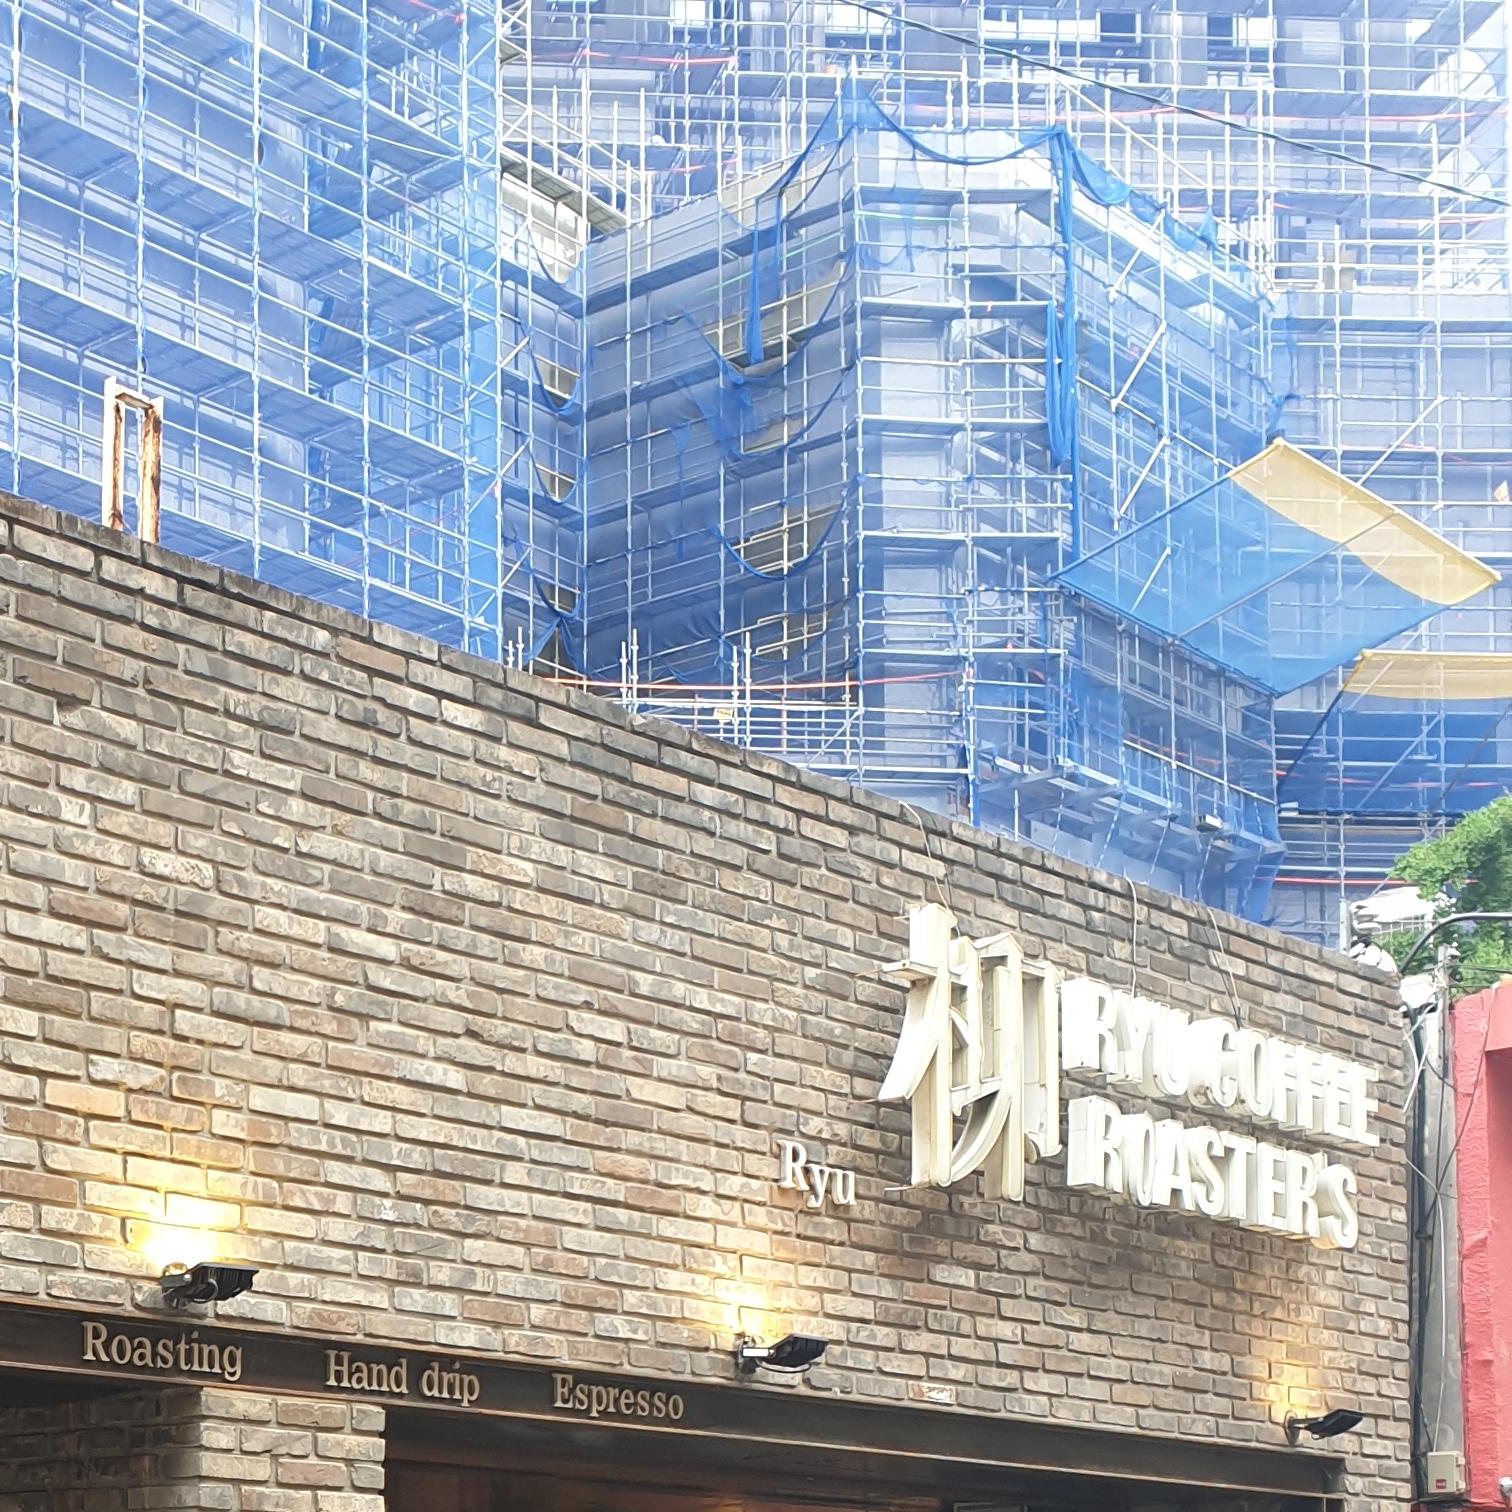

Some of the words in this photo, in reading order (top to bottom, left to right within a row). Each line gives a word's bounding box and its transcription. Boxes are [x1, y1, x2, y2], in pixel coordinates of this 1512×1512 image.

[1060, 977, 1189, 1098] RYU
[1188, 1017, 1379, 1147] COFFEE
[773, 1140, 856, 1207] Ryu
[82, 1321, 243, 1382] Roasting
[325, 1350, 409, 1394] Hand
[421, 1360, 480, 1407] drip
[552, 1373, 684, 1420] Espresso
